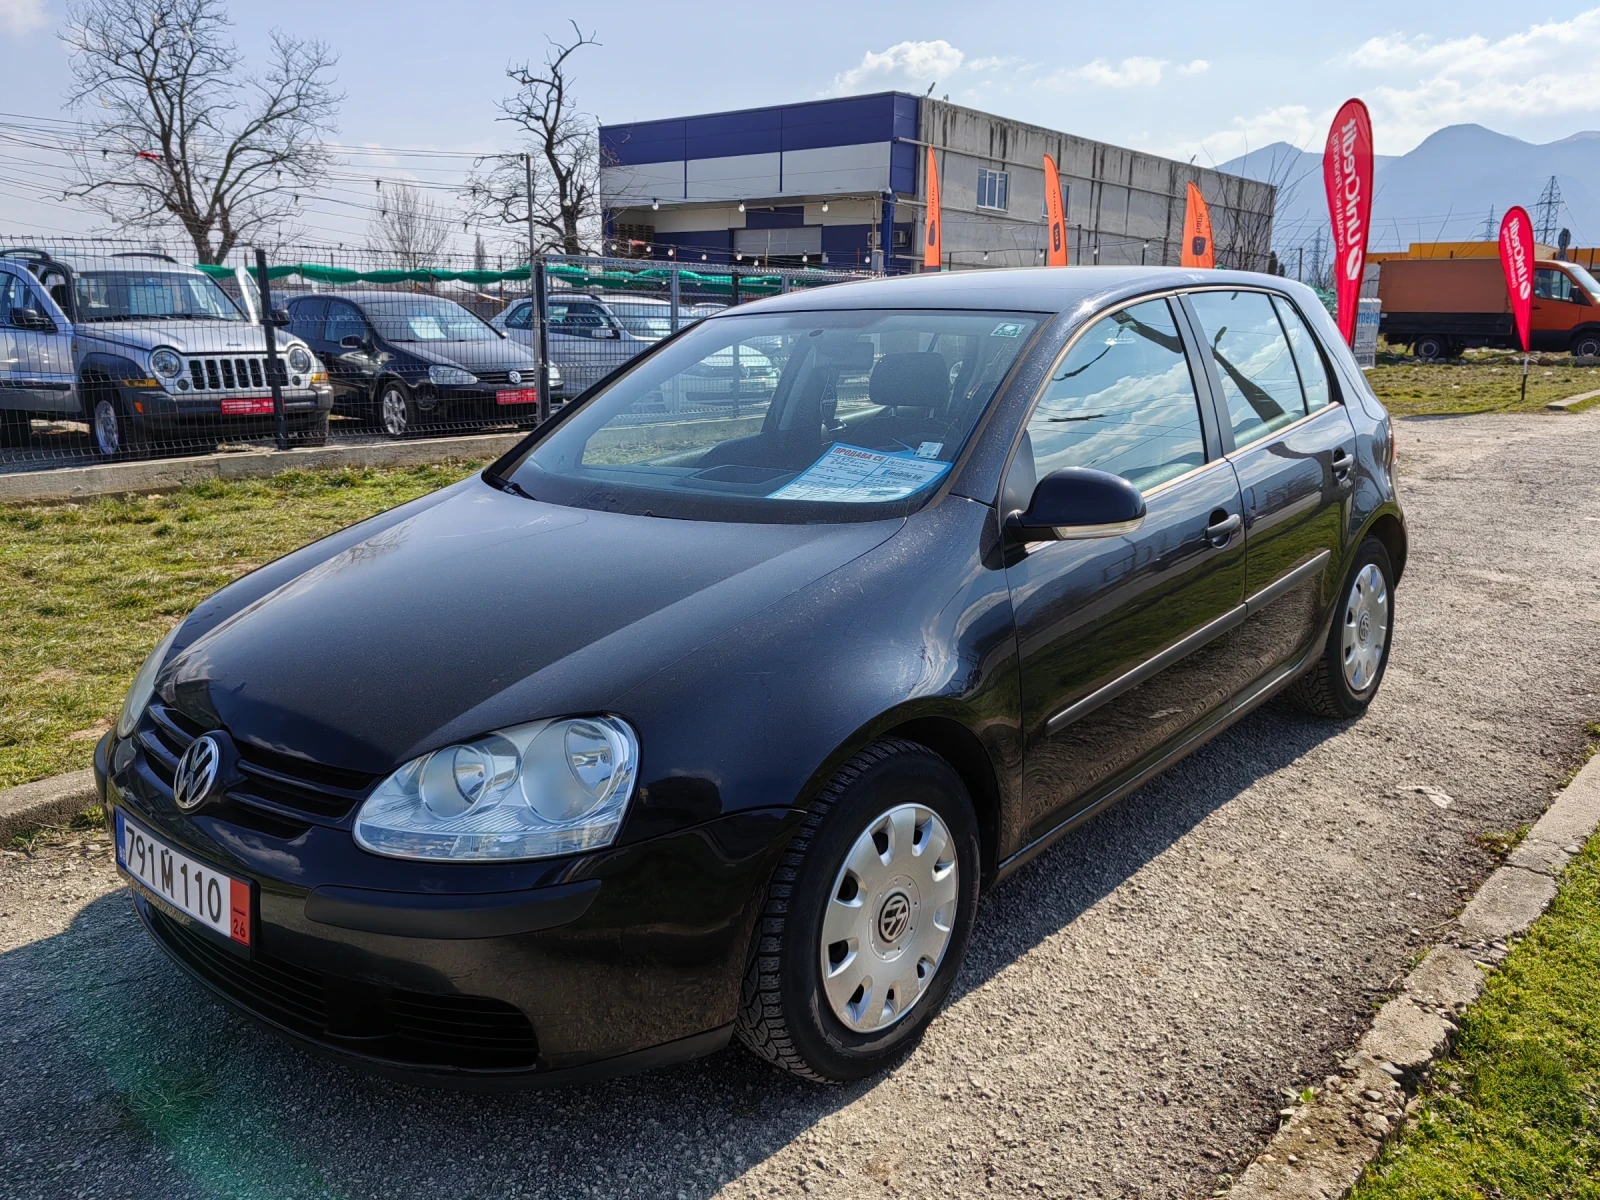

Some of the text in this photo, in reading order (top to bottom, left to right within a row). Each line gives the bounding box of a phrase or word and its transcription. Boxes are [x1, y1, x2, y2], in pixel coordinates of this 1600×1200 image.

[833, 447, 872, 460] ПРОДАВА
[873, 455, 886, 463] СЕ
[233, 917, 247, 938] 26
